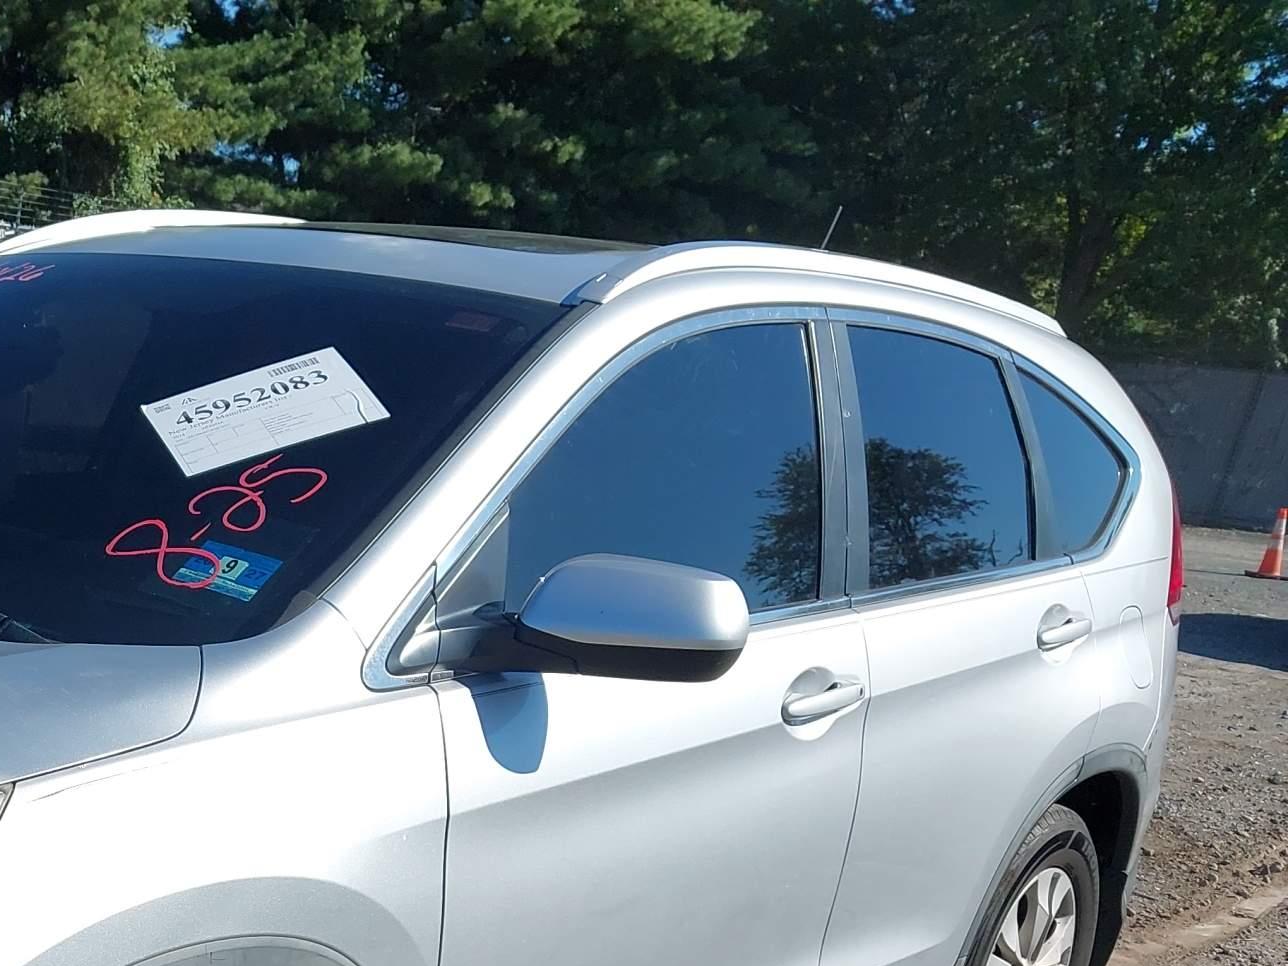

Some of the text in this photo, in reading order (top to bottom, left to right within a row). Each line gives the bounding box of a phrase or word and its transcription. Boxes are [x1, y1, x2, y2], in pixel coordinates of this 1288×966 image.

[175, 369, 329, 426] 45952083
[105, 453, 328, 588] 8-25
[221, 558, 239, 575] 9
